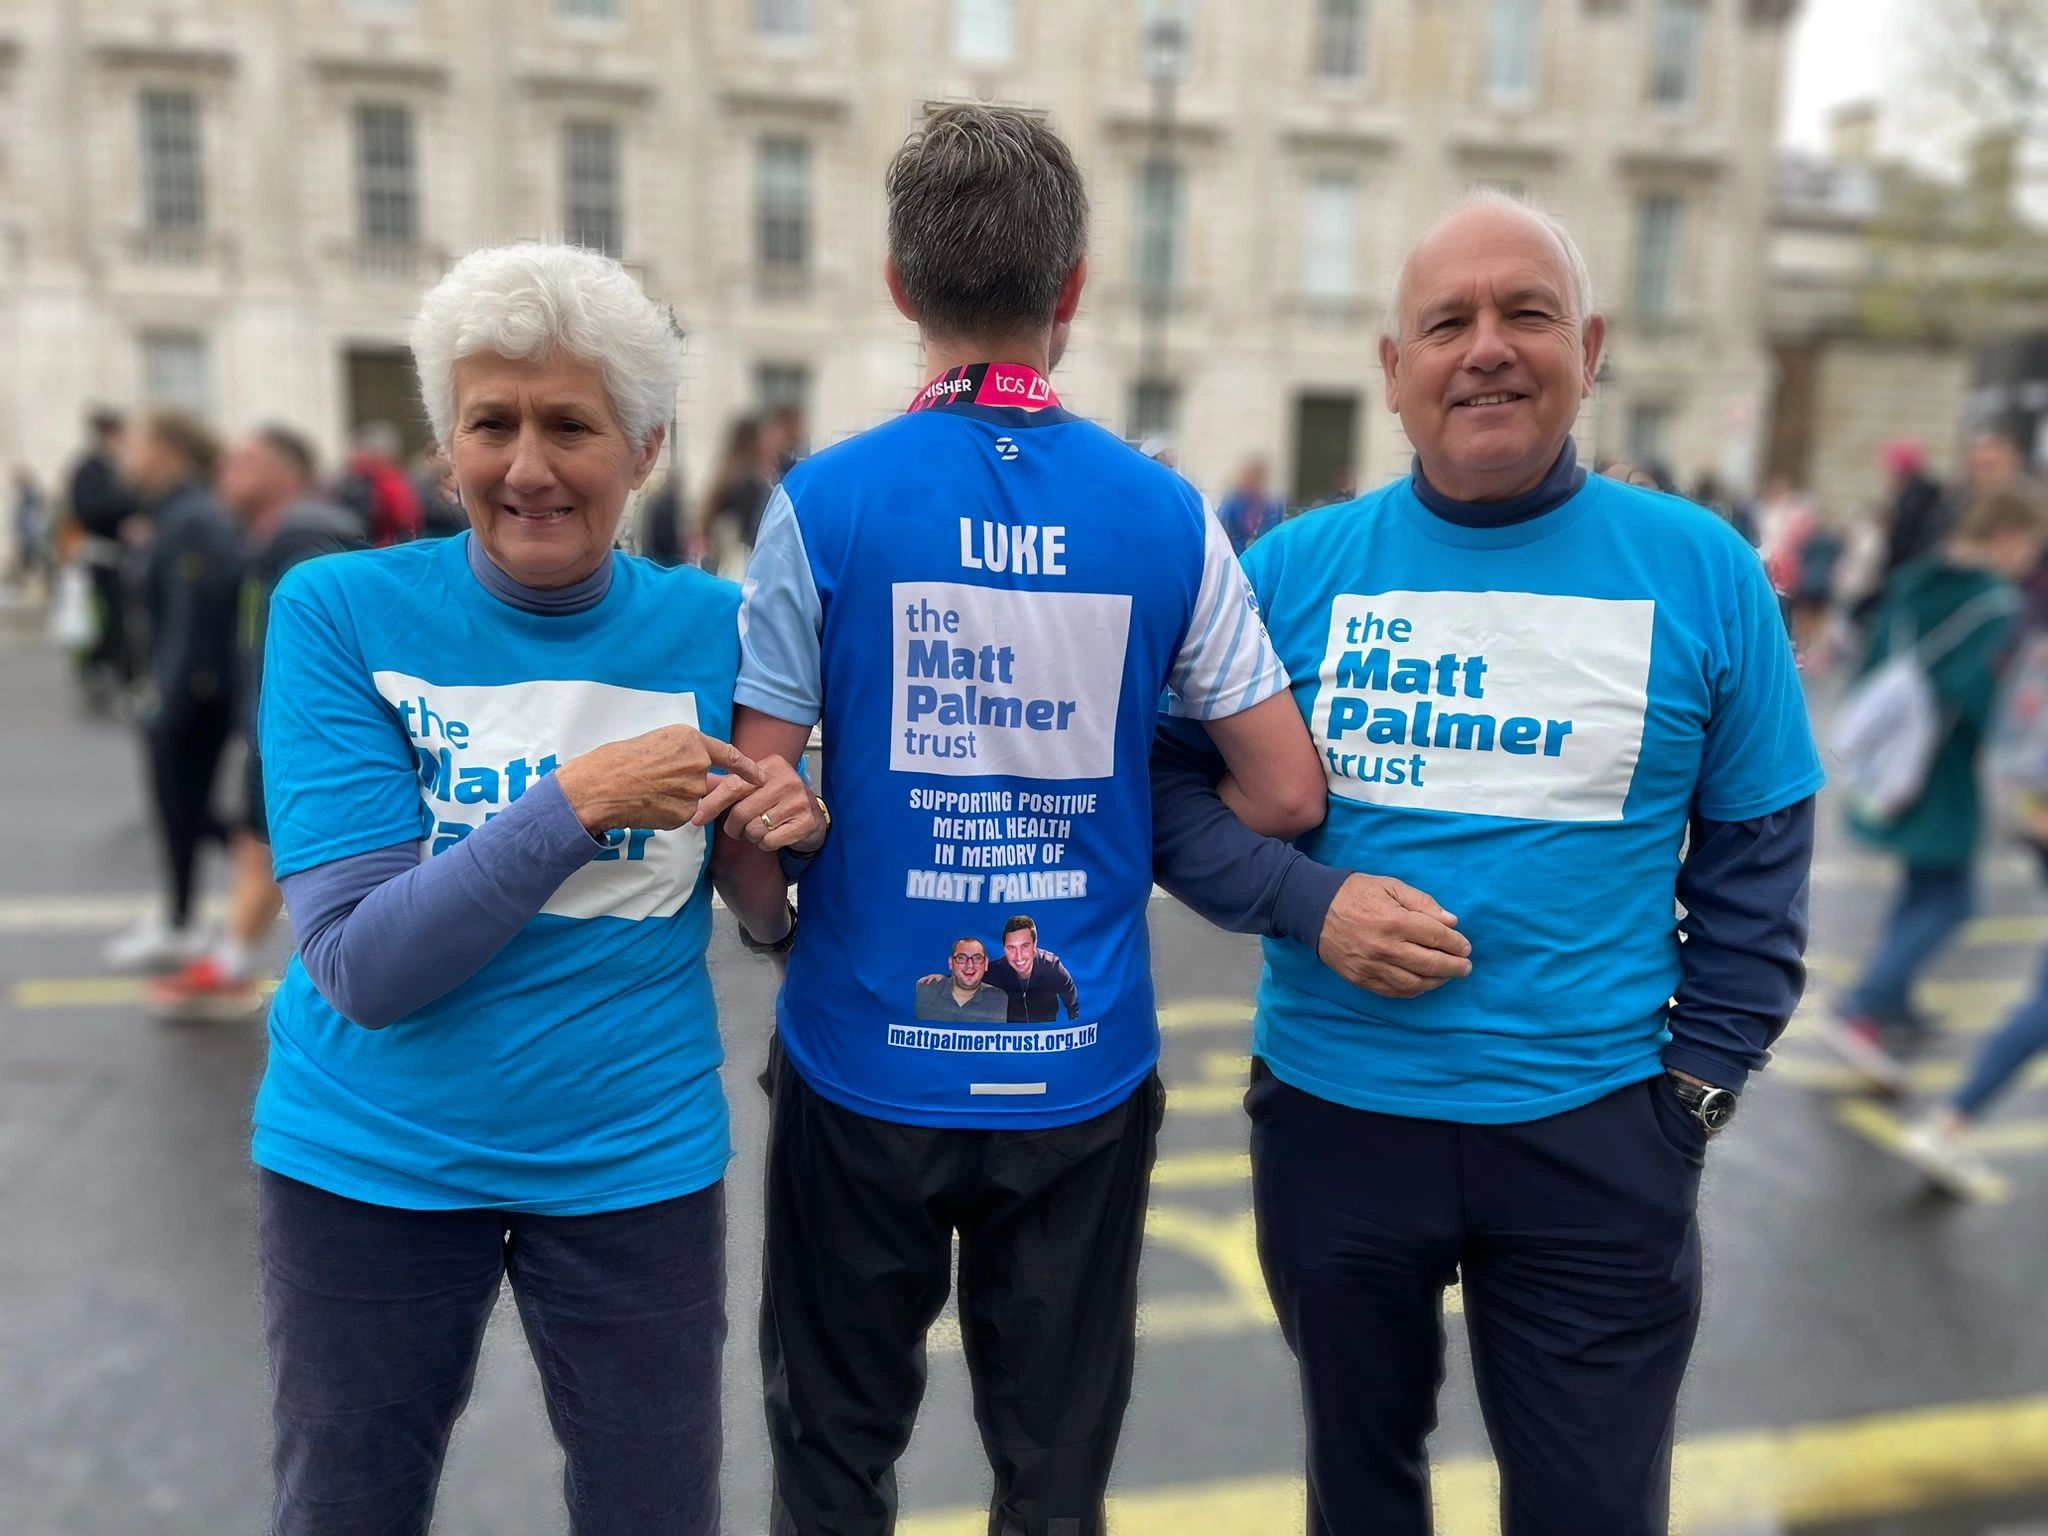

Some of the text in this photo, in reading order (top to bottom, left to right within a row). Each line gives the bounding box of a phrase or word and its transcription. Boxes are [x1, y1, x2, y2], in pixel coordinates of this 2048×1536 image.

[919, 379, 972, 401] NISHER
[995, 372, 1025, 394] tcs
[959, 517, 1066, 576] LUKE
[906, 598, 960, 633] the
[1346, 612, 1412, 644] the
[906, 639, 1015, 684] Matt
[1336, 647, 1488, 698] Matt
[400, 696, 470, 749] the
[906, 685, 1075, 731] Palmer
[904, 727, 977, 758] trust
[1326, 696, 1573, 757] Palmer
[1326, 747, 1426, 787] trust
[909, 788, 1097, 814] SUPPORTING POSITIVE
[932, 816, 1071, 840] MENTAL HEALTH
[934, 843, 1065, 867] IN MEMORY OF
[906, 869, 1088, 903] MATT PALMER
[891, 1026, 1095, 1051] mattpalmertrust.org.uk
